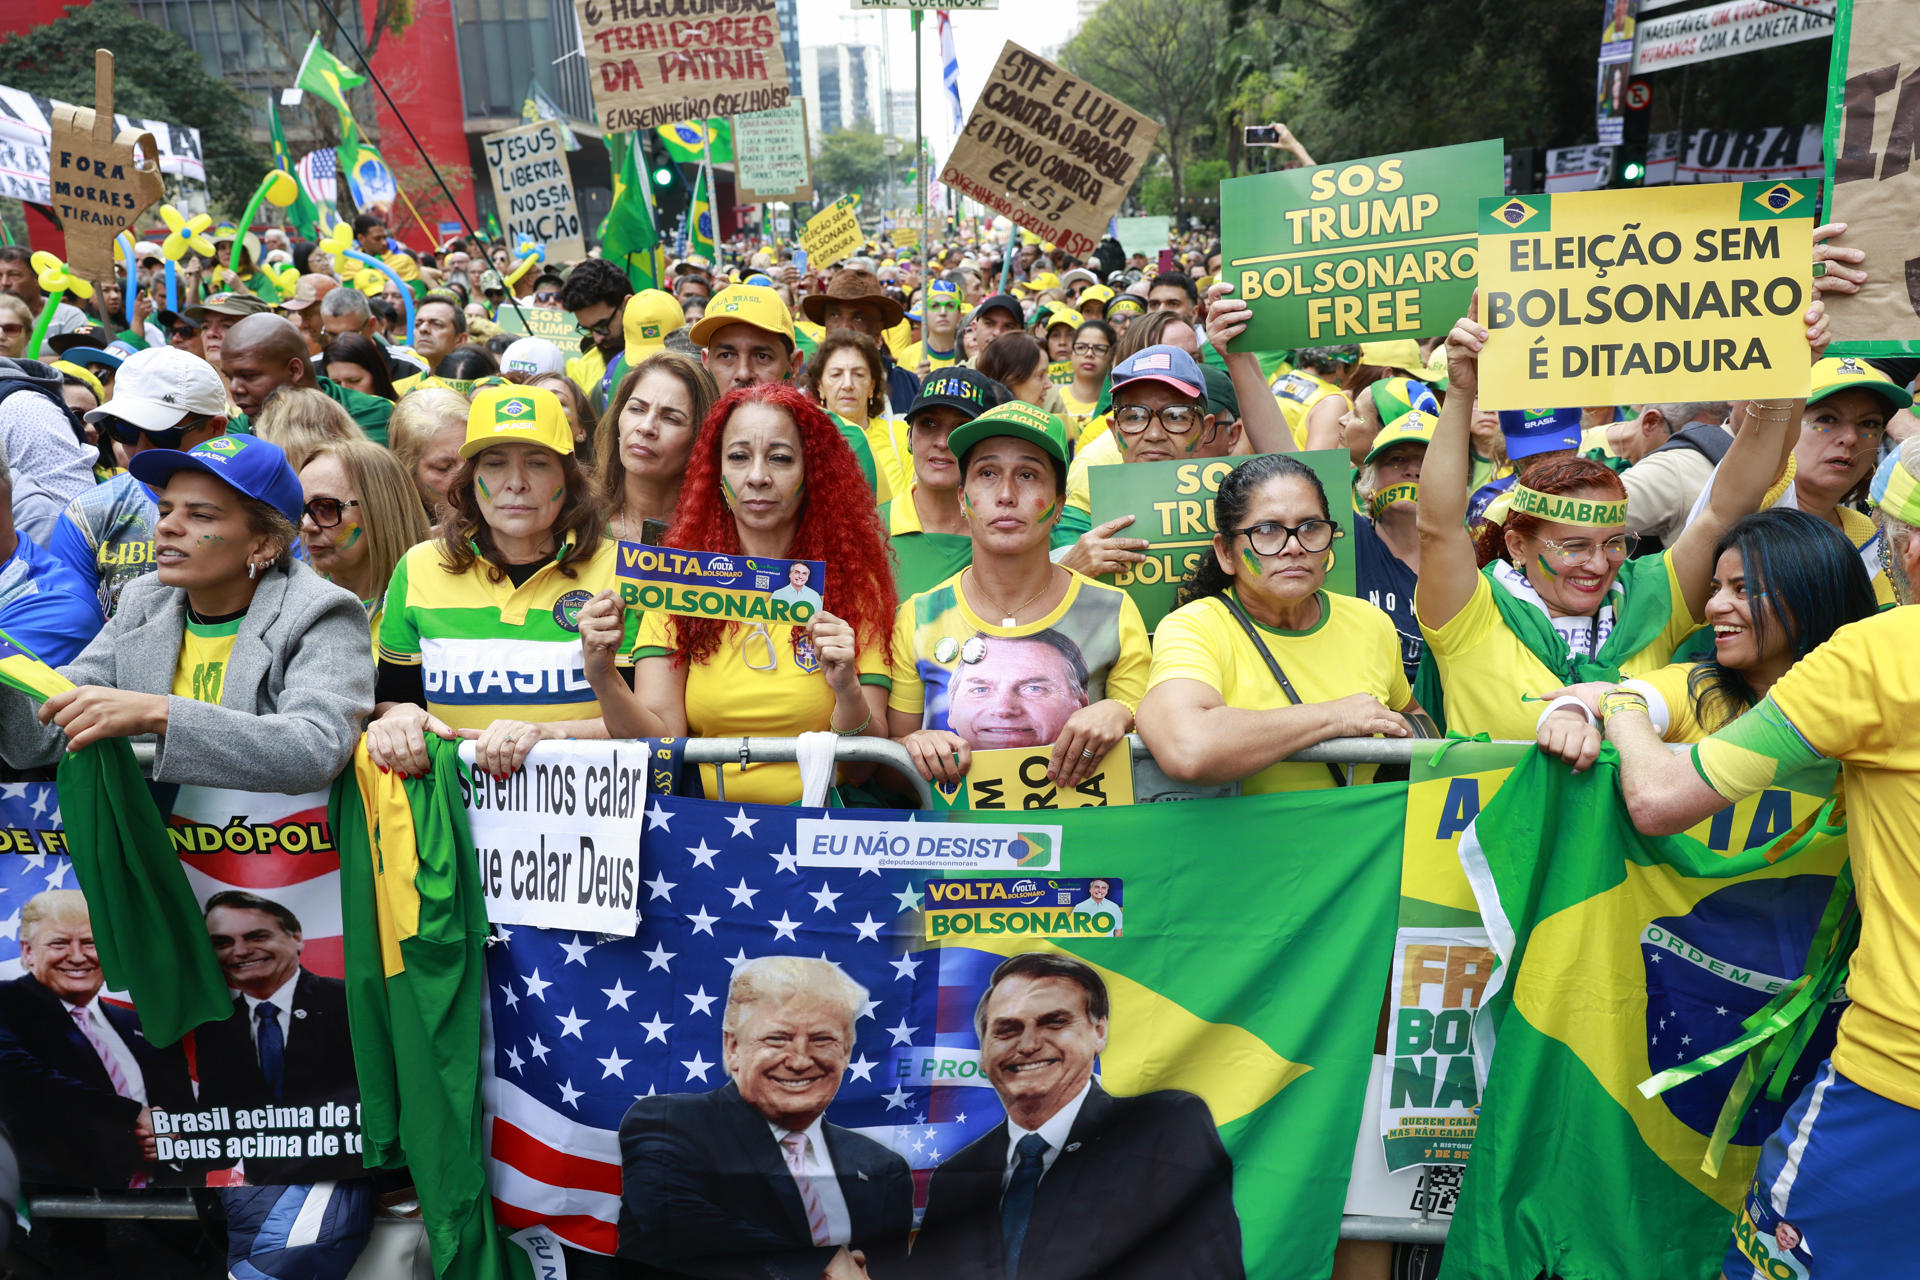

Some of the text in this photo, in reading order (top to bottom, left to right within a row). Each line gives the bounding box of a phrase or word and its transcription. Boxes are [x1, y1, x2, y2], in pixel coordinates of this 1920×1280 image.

[594, 15, 774, 54] TRAIDORES
[1640, 38, 1697, 65] HUMANOS
[1700, 30, 1727, 53] COM
[1731, 30, 1740, 46] A
[1744, 15, 1798, 44] CANETA
[600, 58, 644, 92] DA
[1001, 49, 1139, 148] STF E LULA
[486, 127, 557, 167] JESUS
[983, 82, 1063, 141] CONTRA
[1068, 129, 1136, 187] BRASIL
[60, 151, 125, 181] FORA
[498, 158, 564, 191] LIBERTA
[977, 119, 998, 143] O
[993, 126, 1044, 168] POVO
[1040, 154, 1104, 206] CONTRA
[55, 181, 135, 209] MORAES
[1310, 159, 1405, 202] SOS
[510, 183, 571, 215] NOSSA
[60, 205, 126, 227] TIRANO
[508, 207, 579, 248] NAÇÃO
[803, 209, 848, 244] ELEIÇÃO SEM
[1284, 193, 1439, 246] TRUMP
[1509, 223, 1780, 279] ELEIÇÃO SEM
[1240, 246, 1479, 301] BOLSONARO
[530, 310, 563, 323] SOS
[1308, 288, 1422, 339] FREE
[1488, 276, 1802, 330] BOLSONARO
[1528, 335, 1773, 380] É DITADURA
[923, 378, 984, 407] BRASIL
[493, 422, 538, 433] BRASIL
[1524, 416, 1558, 429] BRASIL
[1176, 462, 1236, 495] SO
[1514, 489, 1627, 524] #REAJABRAS
[622, 547, 703, 577] VOLTA
[702, 570, 744, 578] BOLSONARO
[711, 562, 734, 572] VOLTA
[619, 582, 816, 624] BOLSONARO
[424, 655, 593, 695] BRASIL
[536, 763, 577, 817] nos
[584, 749, 642, 819] calar
[166, 816, 334, 854] NDÓPOL
[812, 835, 847, 855] EU
[854, 831, 910, 857] NÃO
[476, 833, 634, 910] ue calar Deus
[928, 882, 1009, 902] VOLTA
[1008, 890, 1046, 900] BOLSONARO
[1016, 884, 1037, 893] VOLTA
[932, 911, 1117, 937] BOLSONARO
[1647, 927, 1784, 993] ORDEM E
[896, 1058, 913, 1079] E
[152, 1102, 351, 1134] Brasil acima de
[1390, 1127, 1475, 1138] MAS NÃO CALAR
[1402, 1117, 1477, 1127] QUEREM CALA
[155, 1137, 223, 1161] Deus
[226, 1132, 302, 1158] acima
[307, 1130, 341, 1157] de
[1424, 1149, 1470, 1160] 7 DE SE
[526, 1236, 554, 1260] EU
